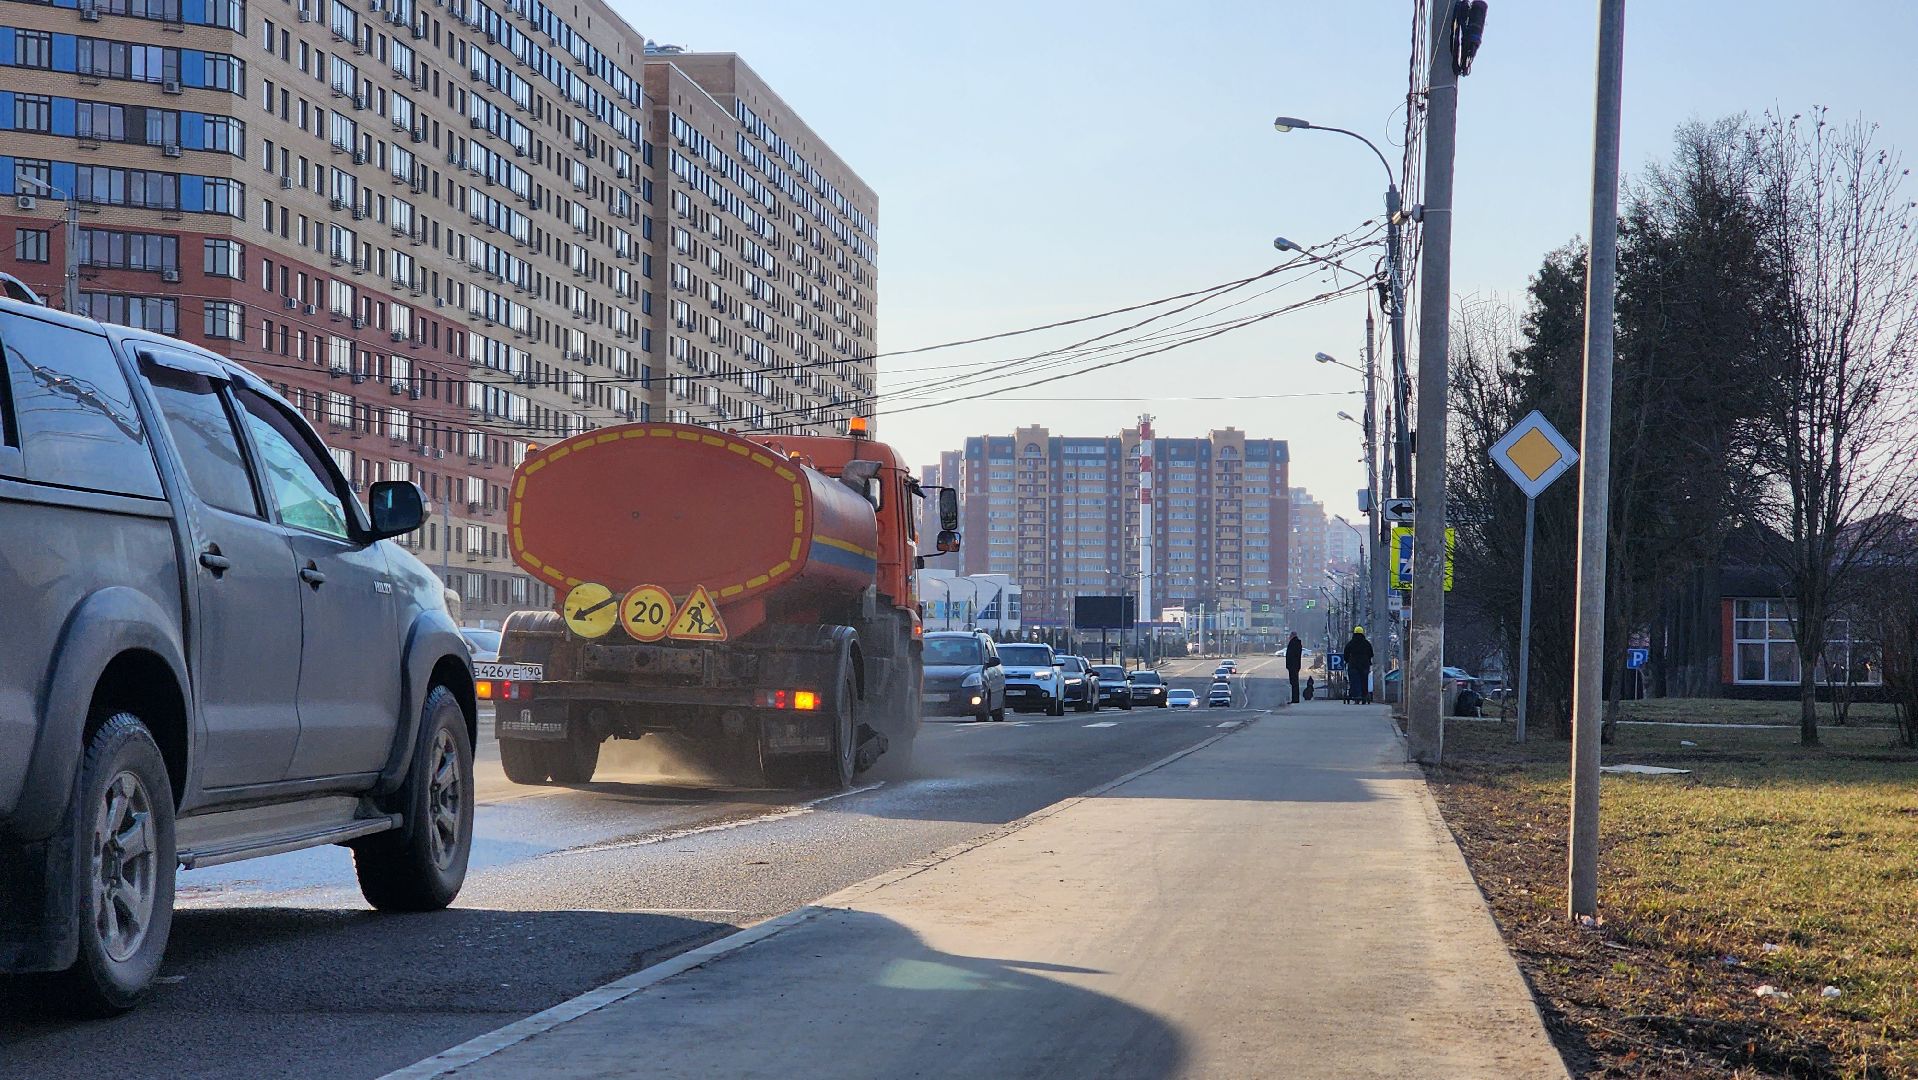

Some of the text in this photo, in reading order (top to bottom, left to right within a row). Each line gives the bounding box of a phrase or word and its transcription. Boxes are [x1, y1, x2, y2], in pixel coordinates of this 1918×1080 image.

[632, 601, 664, 625] 20
[1331, 655, 1342, 670] P
[1633, 651, 1644, 667] P
[521, 666, 541, 676] 190
